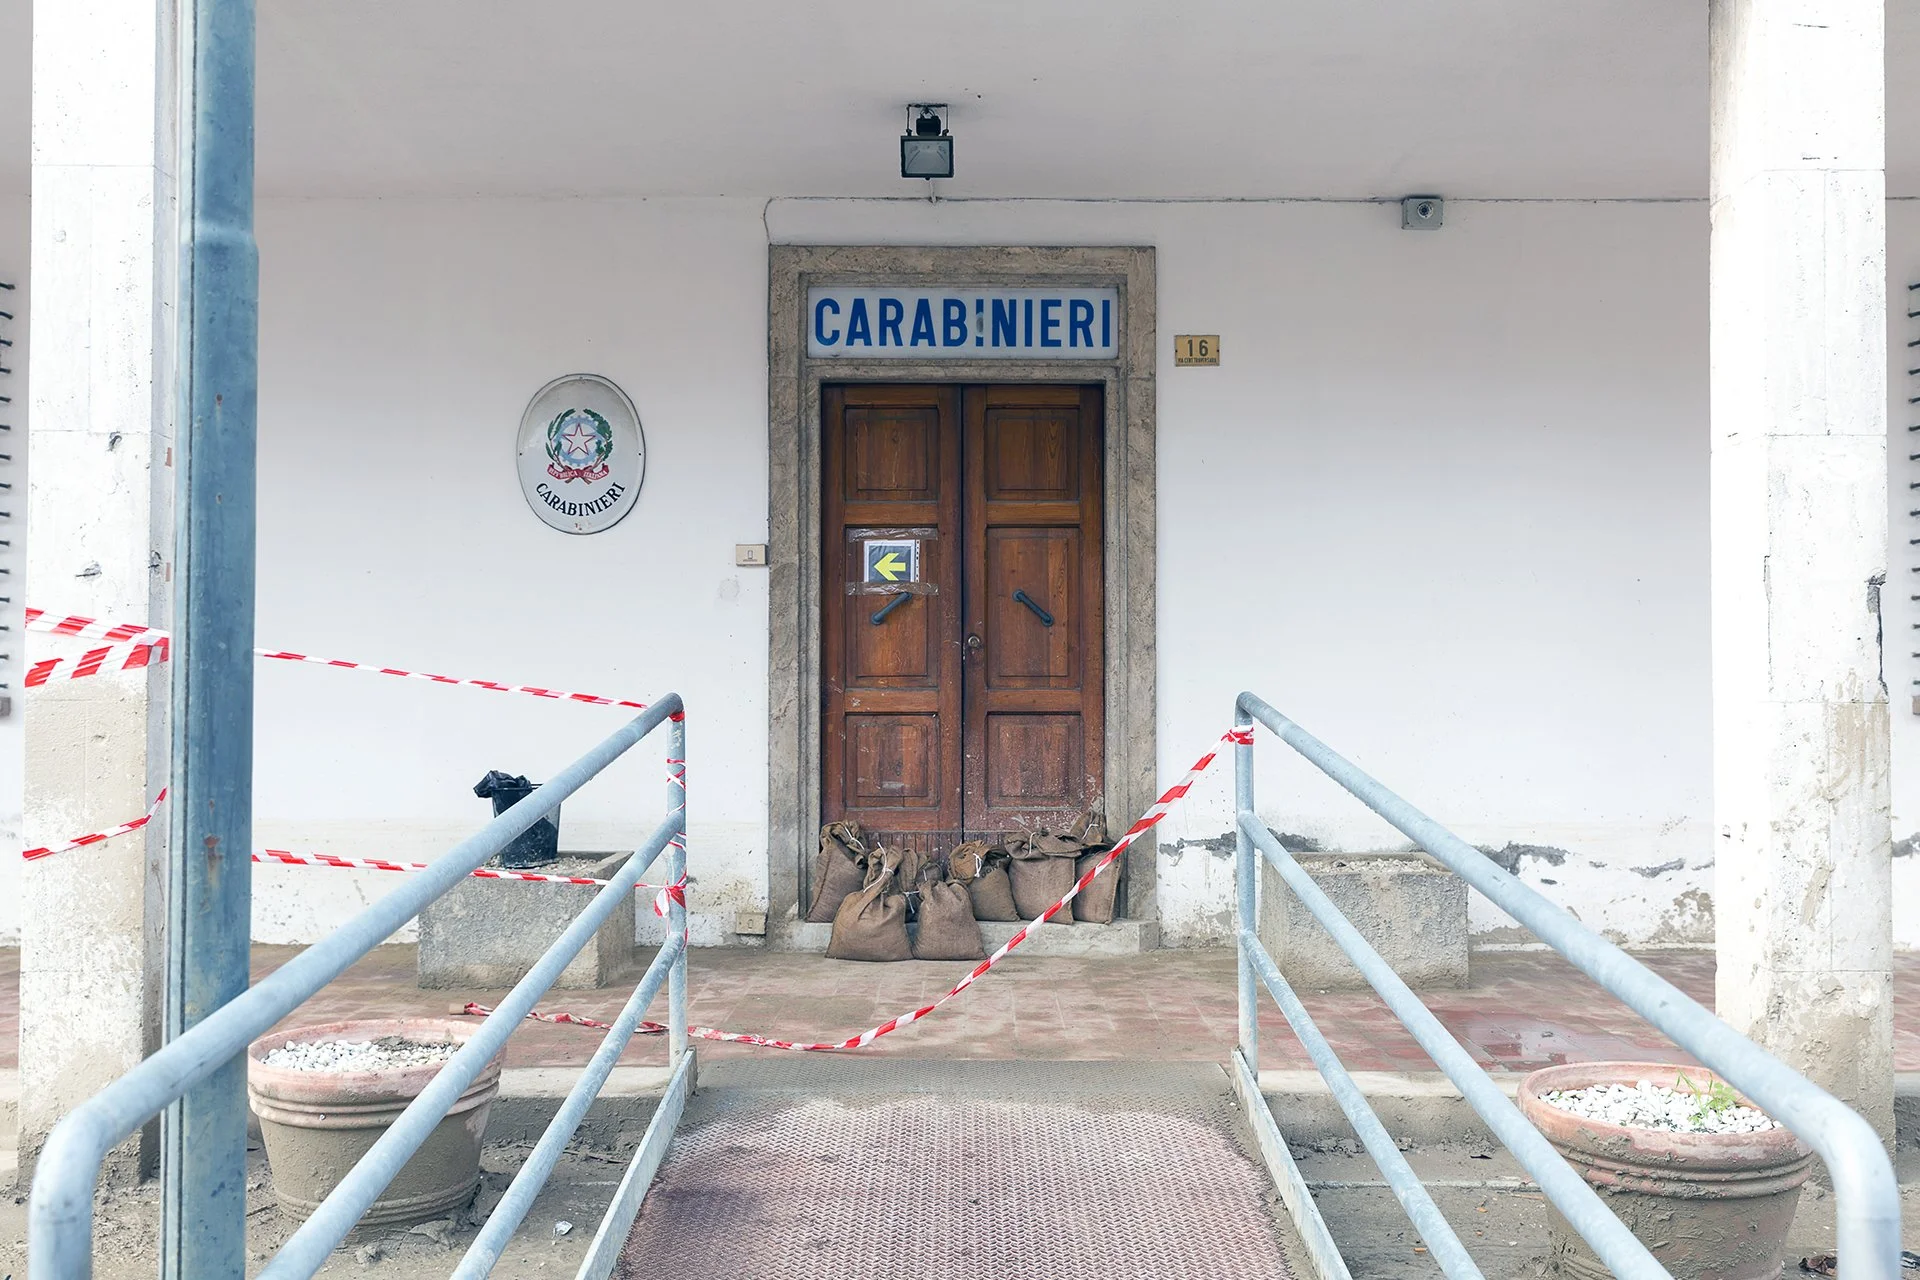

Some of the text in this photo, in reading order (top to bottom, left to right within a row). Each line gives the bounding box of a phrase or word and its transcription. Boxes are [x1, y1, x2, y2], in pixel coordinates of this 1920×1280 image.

[815, 298, 1110, 347] CARABINIERI
[1187, 339, 1208, 357] 16
[536, 481, 626, 516] CARABINIERI
